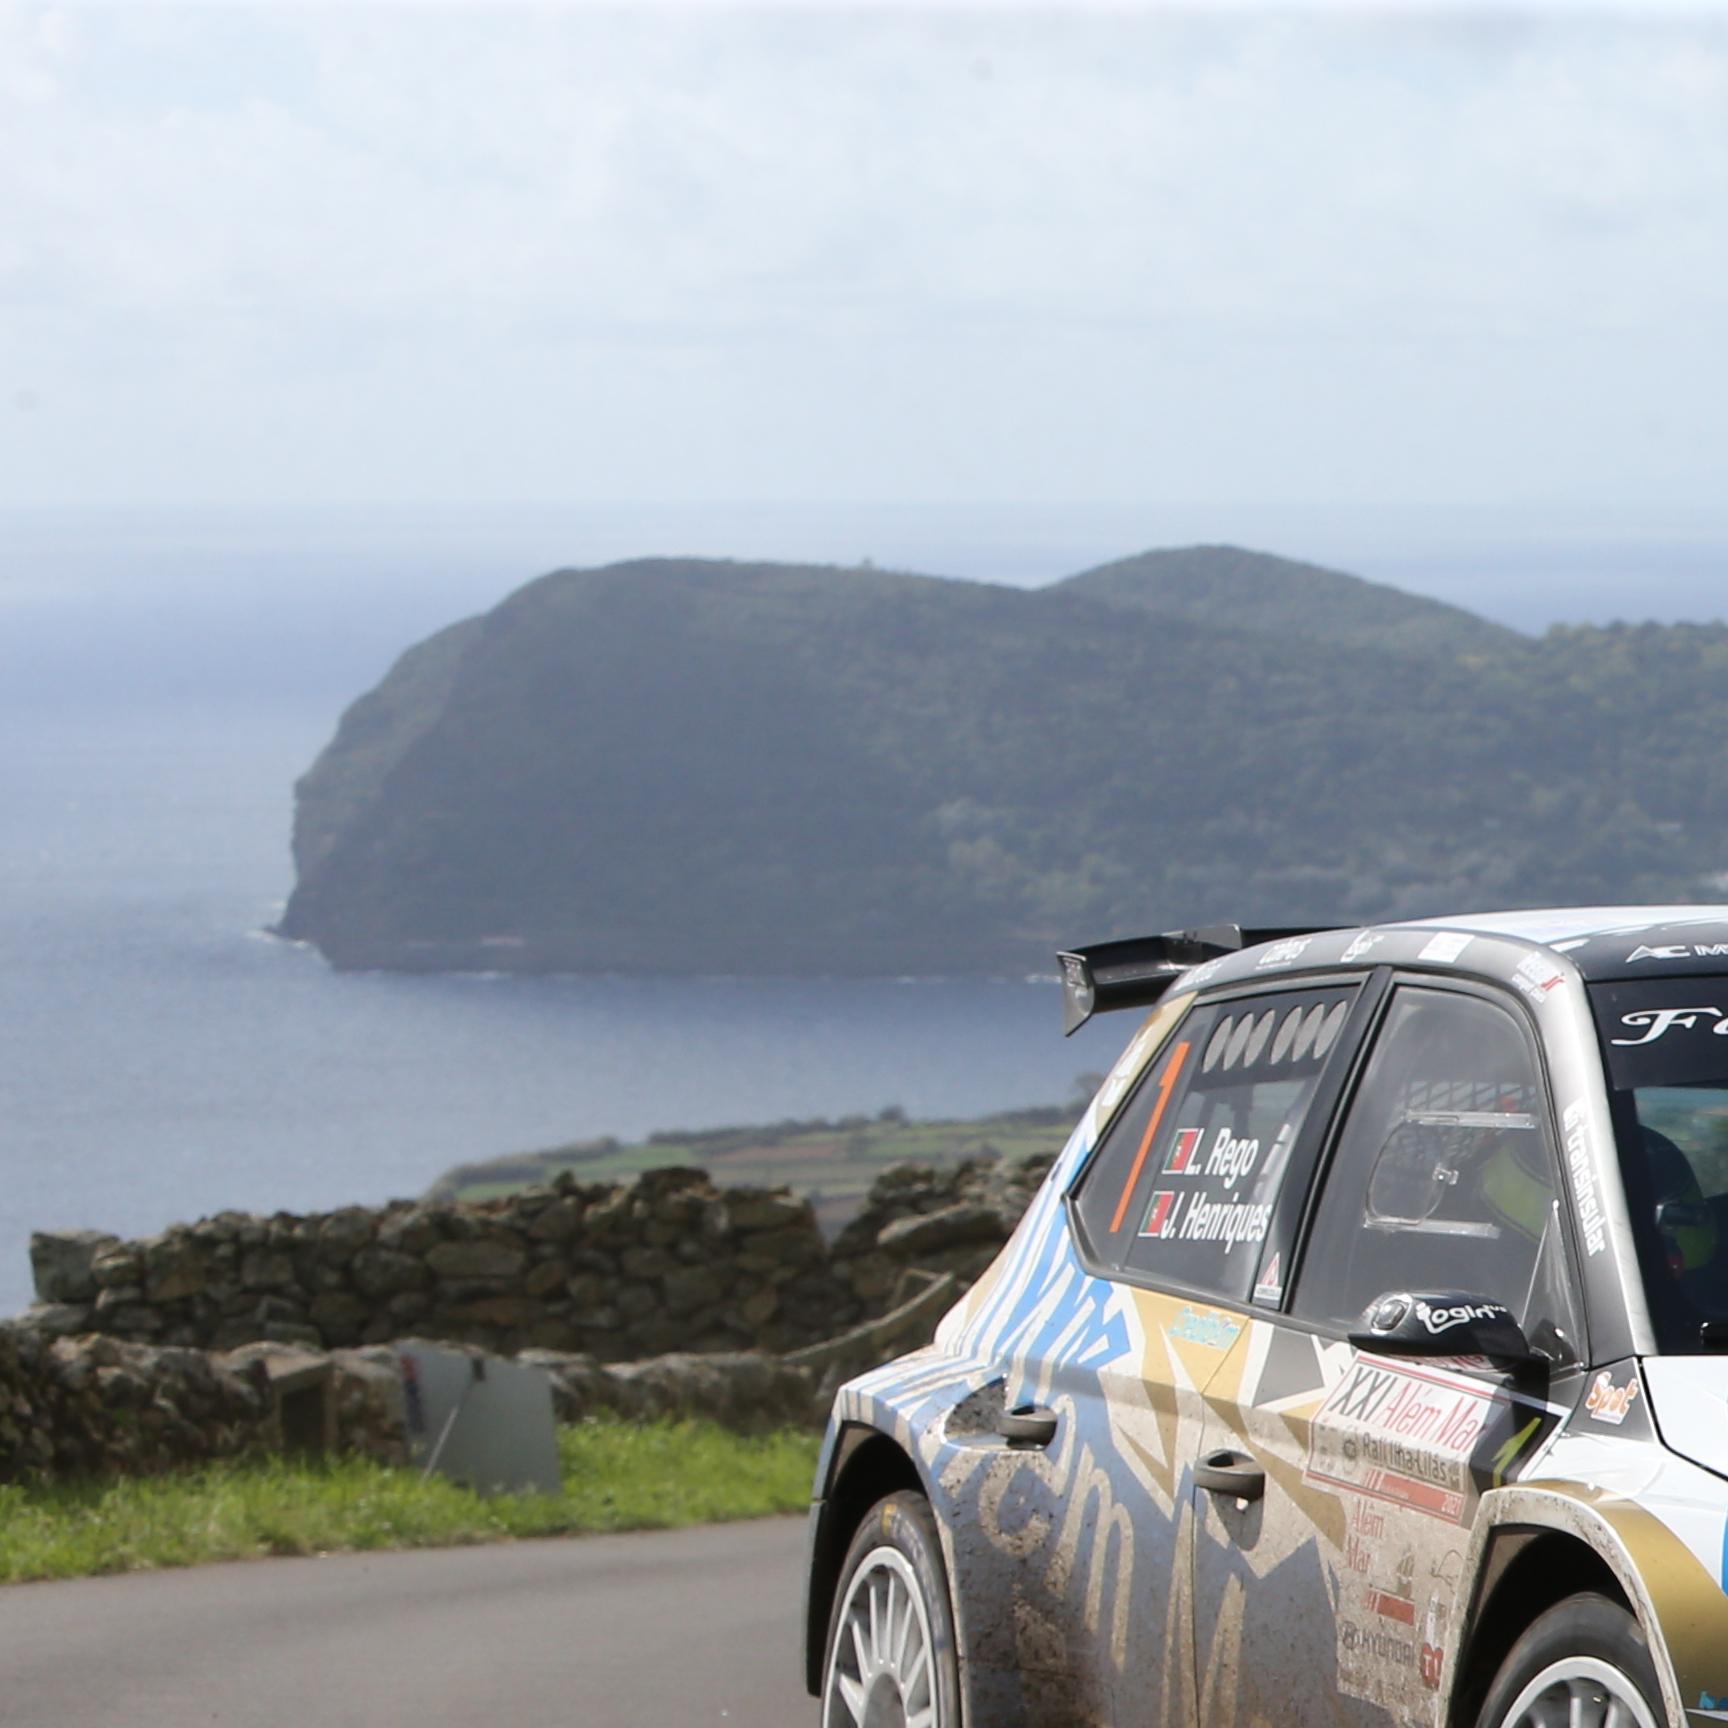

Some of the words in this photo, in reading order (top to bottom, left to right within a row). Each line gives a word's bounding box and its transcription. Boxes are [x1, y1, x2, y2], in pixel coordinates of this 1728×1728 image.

[1183, 1128, 1205, 1175] L.
[1205, 1128, 1260, 1189] Rego
[1160, 1191, 1186, 1240] J.
[1178, 1191, 1273, 1255] Henriques
[1328, 1367, 1398, 1422] XXI
